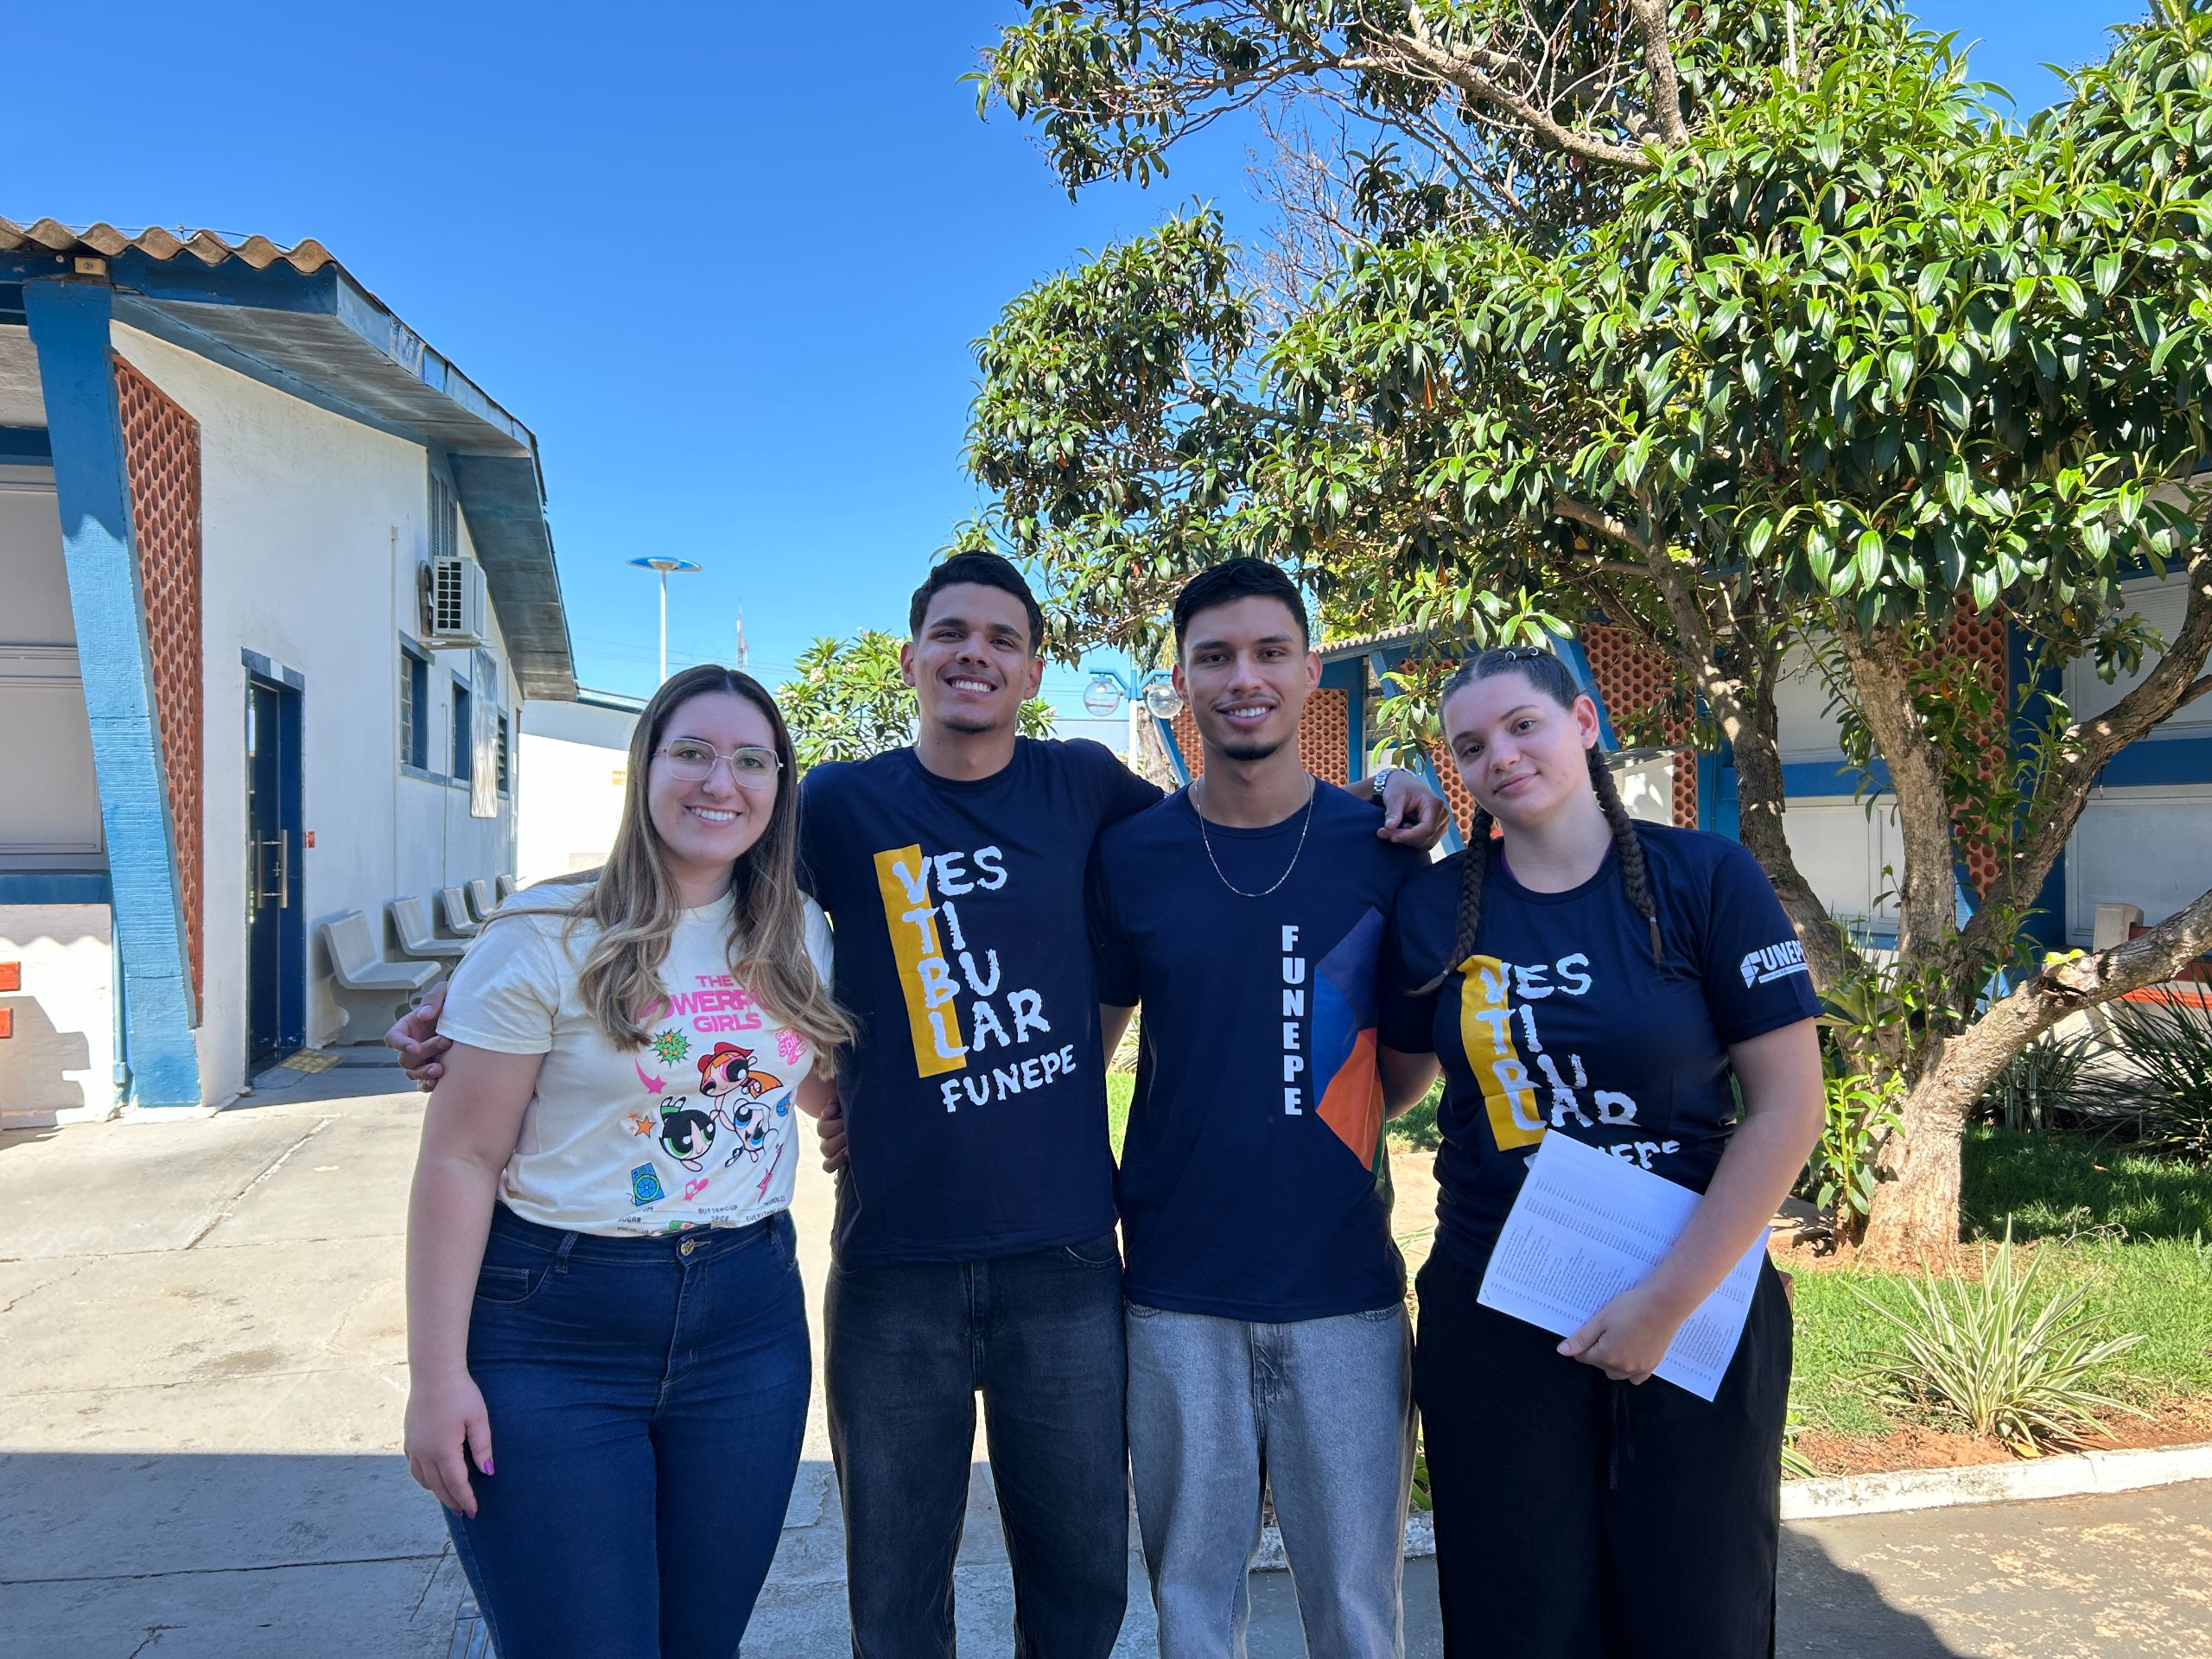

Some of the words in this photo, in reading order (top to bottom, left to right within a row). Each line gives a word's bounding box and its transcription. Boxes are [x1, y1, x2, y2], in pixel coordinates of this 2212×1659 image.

[893, 846, 1007, 904] VES
[902, 901, 966, 954] TI
[695, 975, 734, 988] THE
[918, 949, 1001, 1008] BU
[1480, 953, 1592, 1003] VES
[1740, 940, 1807, 988] FUNEP
[693, 1012, 762, 1033] GIRLS
[928, 988, 1051, 1058] LAR
[1281, 925, 1306, 1115] FUNEPE
[1476, 1004, 1542, 1055] TI
[940, 1045, 1076, 1112] FUNEPE
[698, 1205, 738, 1215] BUTTERCUP
